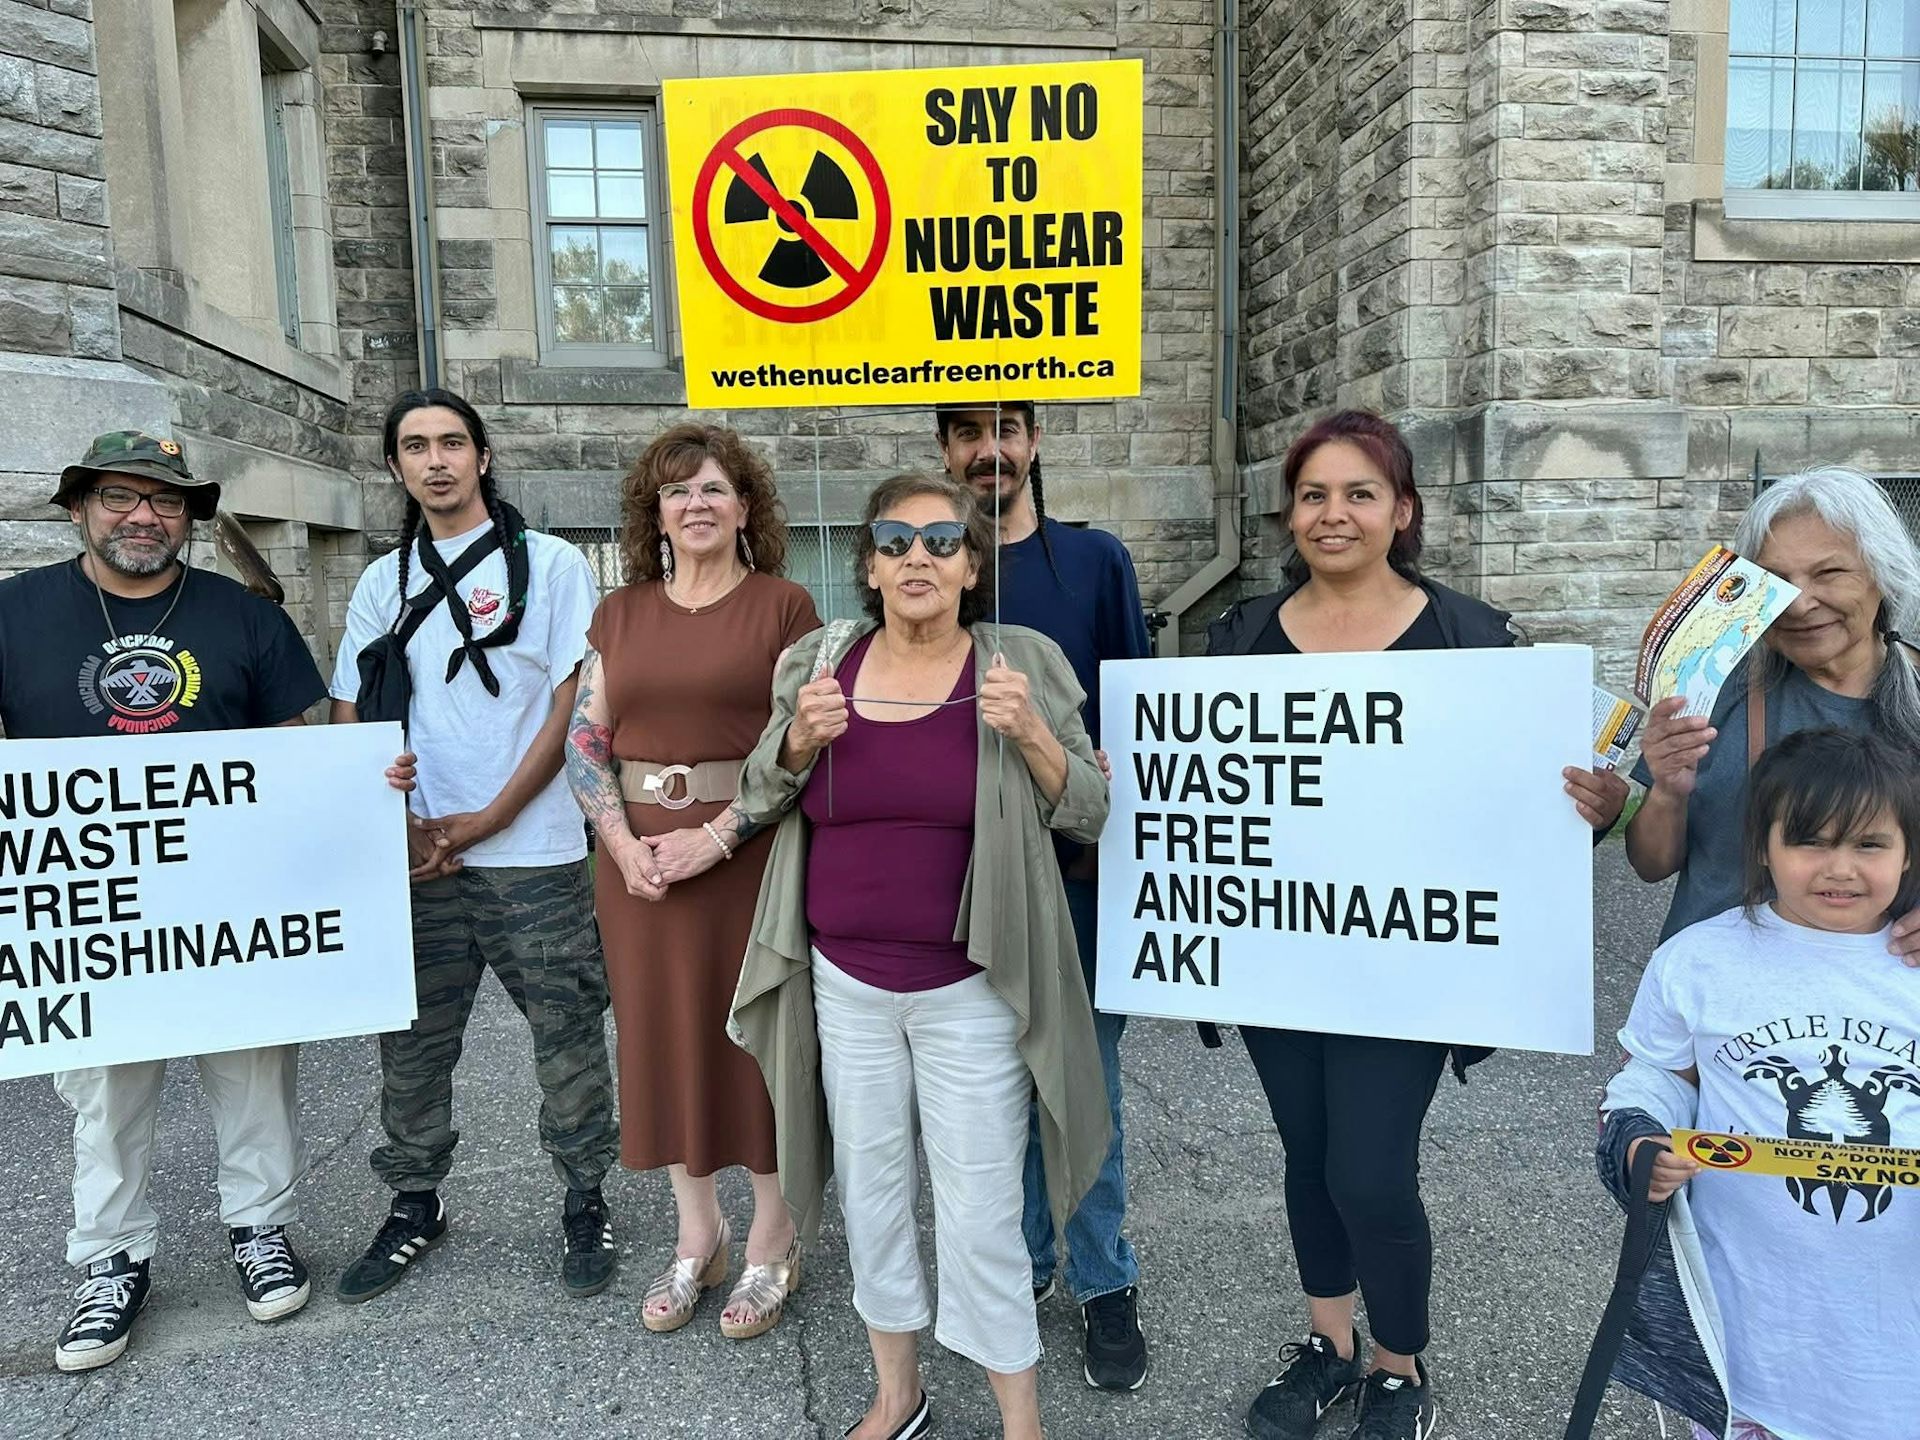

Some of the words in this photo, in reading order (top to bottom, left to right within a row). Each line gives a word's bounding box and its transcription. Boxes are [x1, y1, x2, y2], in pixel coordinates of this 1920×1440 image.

[926, 87, 1016, 145] SAY
[1032, 83, 1098, 141] NO
[986, 155, 1037, 202] TO
[905, 211, 1123, 273] NUCLEAR
[930, 281, 1098, 341] WASTE
[711, 356, 1115, 388] wethenuclearfreenorth.ca
[1670, 586, 1702, 620] Northern
[1643, 627, 1659, 657] Nuclear
[1655, 605, 1677, 628] Waste
[1136, 692, 1403, 743] NUCLEAR
[1133, 753, 1323, 806] WASTE
[1136, 813, 1272, 867] FREE
[1134, 872, 1499, 945] ANISHINAABE
[0, 910, 343, 988] ANISHINAABE
[1132, 932, 1219, 986] AKI
[0, 992, 91, 1048] AKI
[1714, 1015, 1829, 1071] TURTLE
[1840, 1017, 1920, 1069] ISLA
[1756, 1136, 1820, 1149] NUCLEAR
[1825, 1143, 1876, 1154] WASTE
[1880, 1147, 1895, 1155] IN
[1774, 1147, 1815, 1159] NOT
[1821, 1151, 1834, 1161] A
[1816, 1164, 1868, 1181] SAY
[1877, 1170, 1920, 1185] NO
